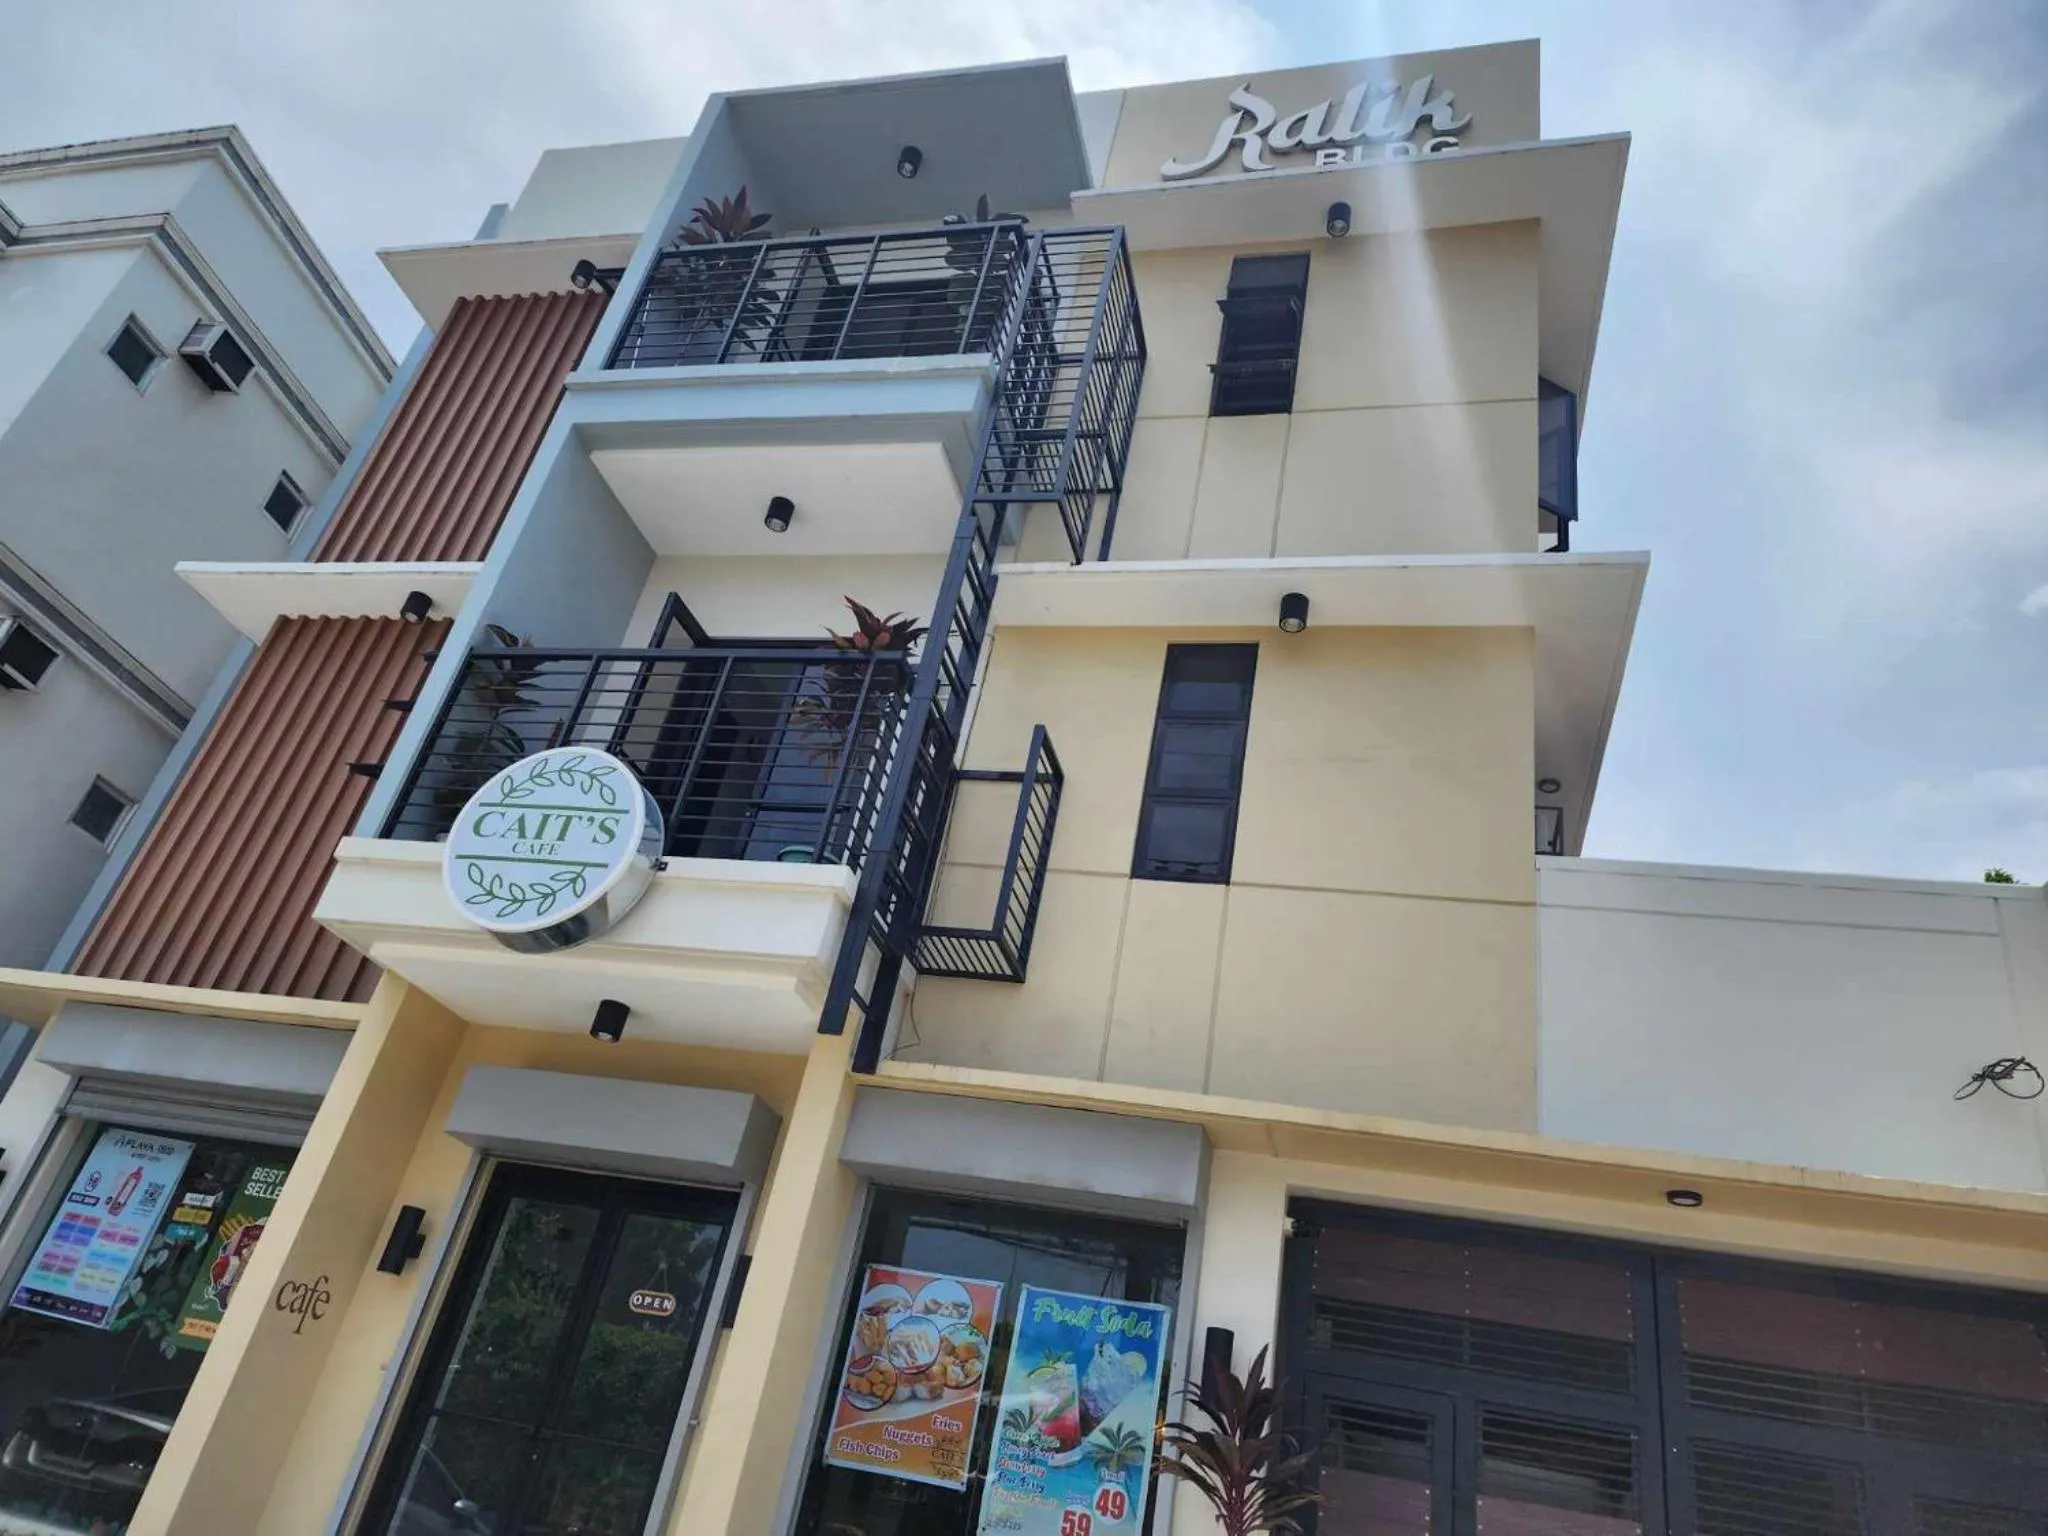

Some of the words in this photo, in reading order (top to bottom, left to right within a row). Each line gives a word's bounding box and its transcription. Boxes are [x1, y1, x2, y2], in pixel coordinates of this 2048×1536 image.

[1160, 73, 1473, 181] Ralik
[473, 811, 620, 845] CAIT'S
[512, 843, 561, 856] CAFE
[251, 1166, 286, 1184] BEST
[633, 1294, 673, 1310] OPEN
[1096, 1305, 1153, 1339] Soda
[931, 1413, 962, 1432] Fries
[883, 1424, 934, 1448] Nuggets
[1095, 1487, 1126, 1521] 49
[1060, 1509, 1092, 1536] 59
